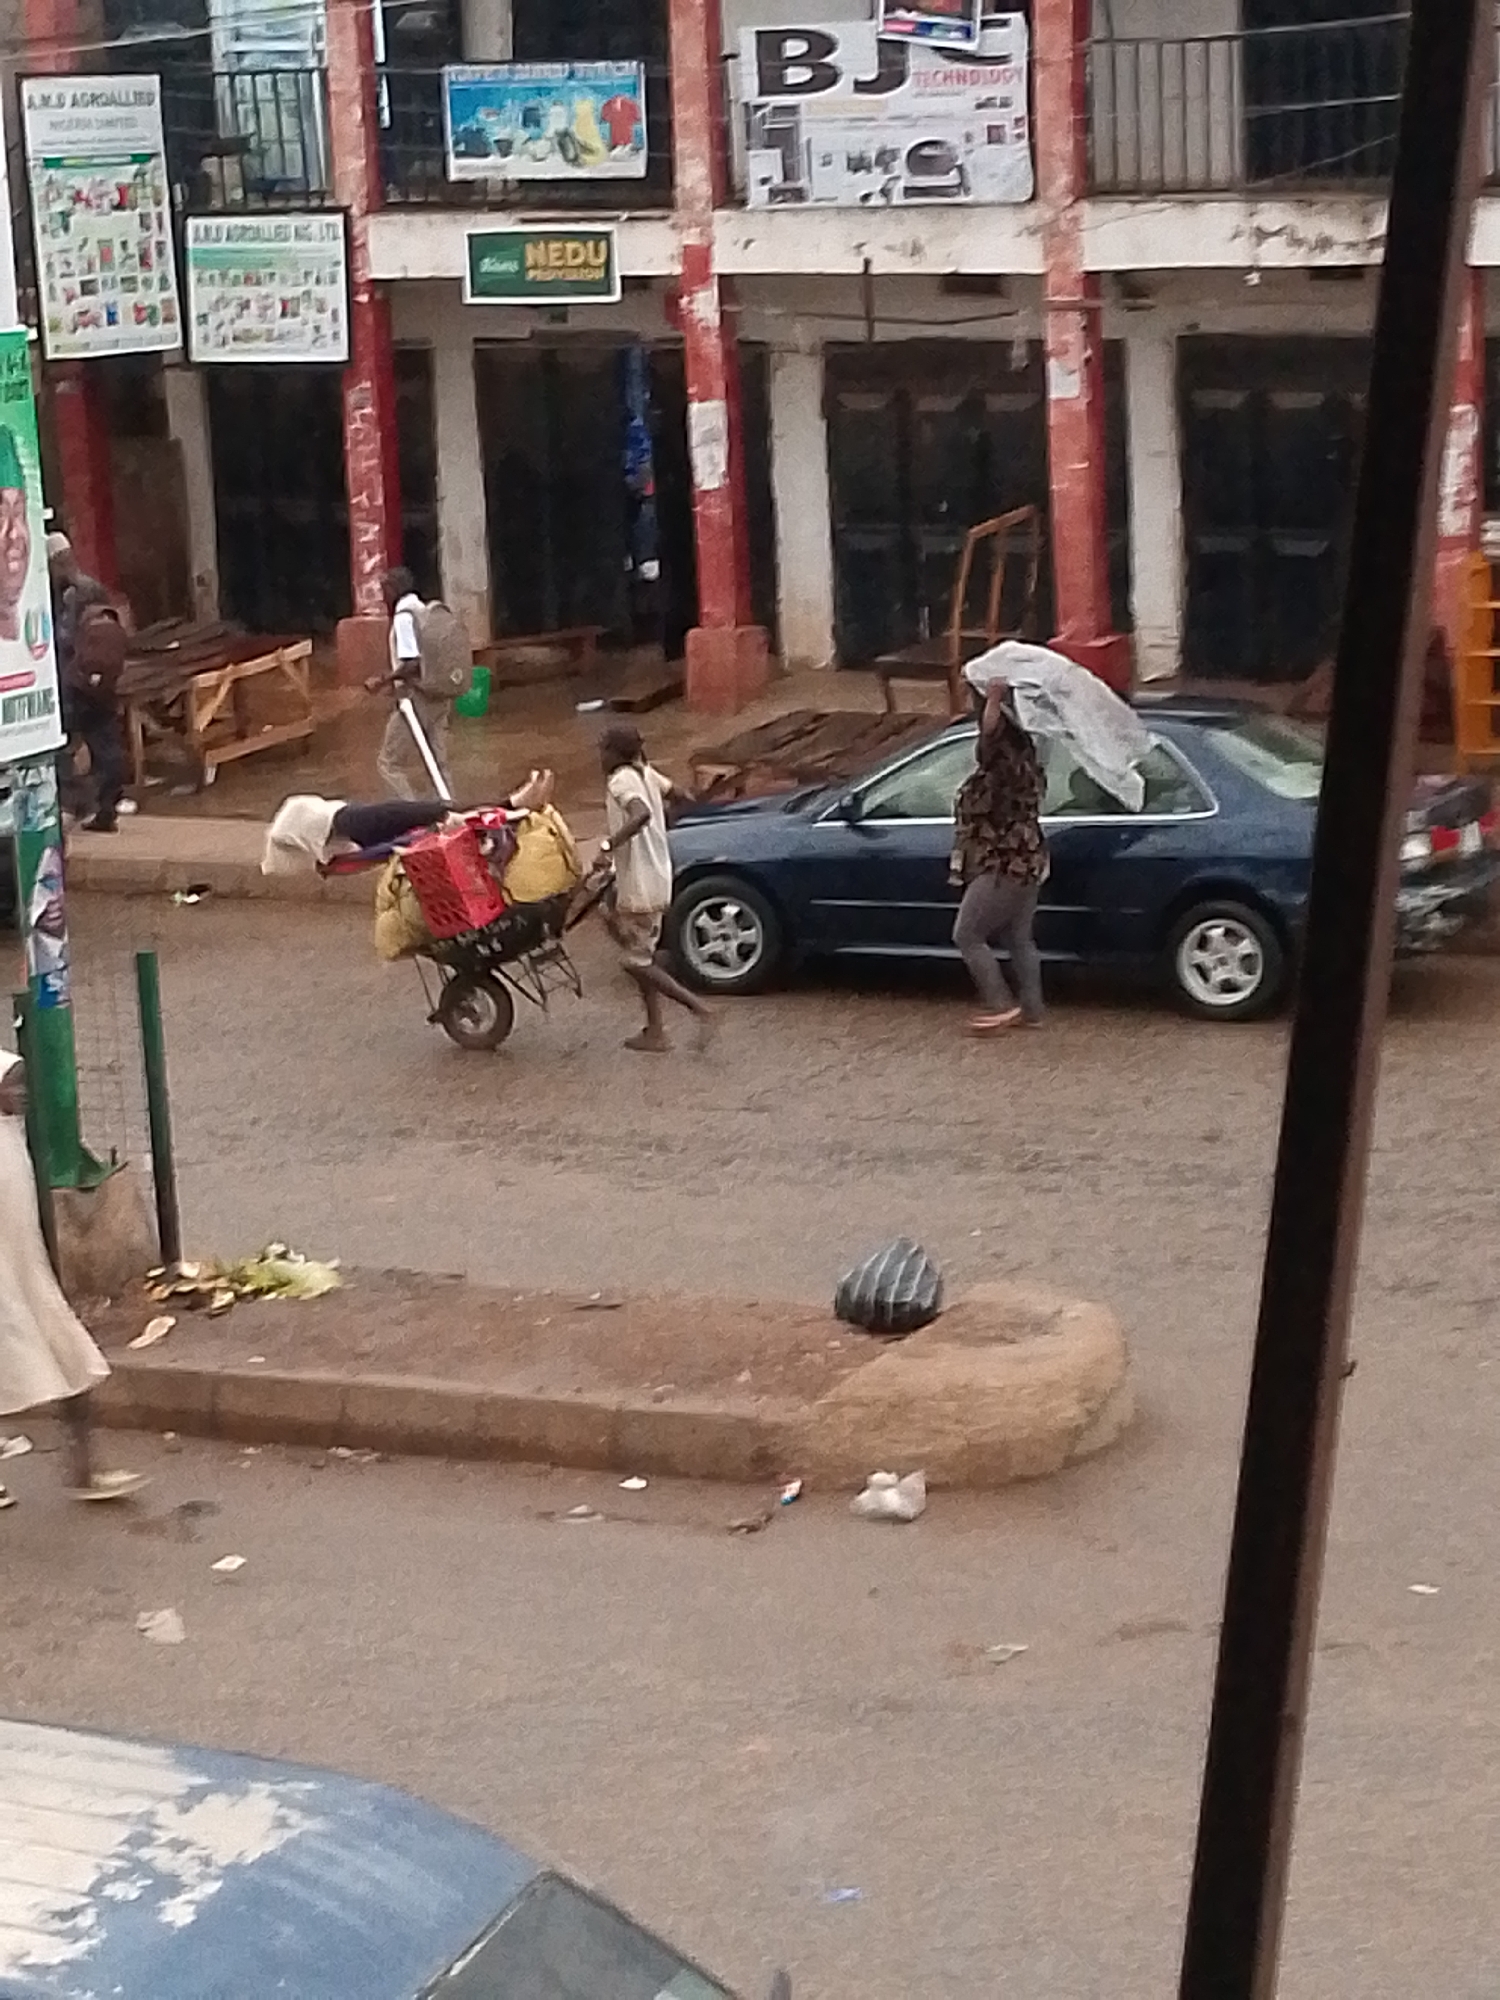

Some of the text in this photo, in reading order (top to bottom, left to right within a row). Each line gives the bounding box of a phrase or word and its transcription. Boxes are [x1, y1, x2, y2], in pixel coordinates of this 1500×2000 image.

[912, 67, 1024, 88] TECHNOLOGY
[70, 89, 156, 109] AGROALLIED
[525, 239, 608, 267] NEDU
